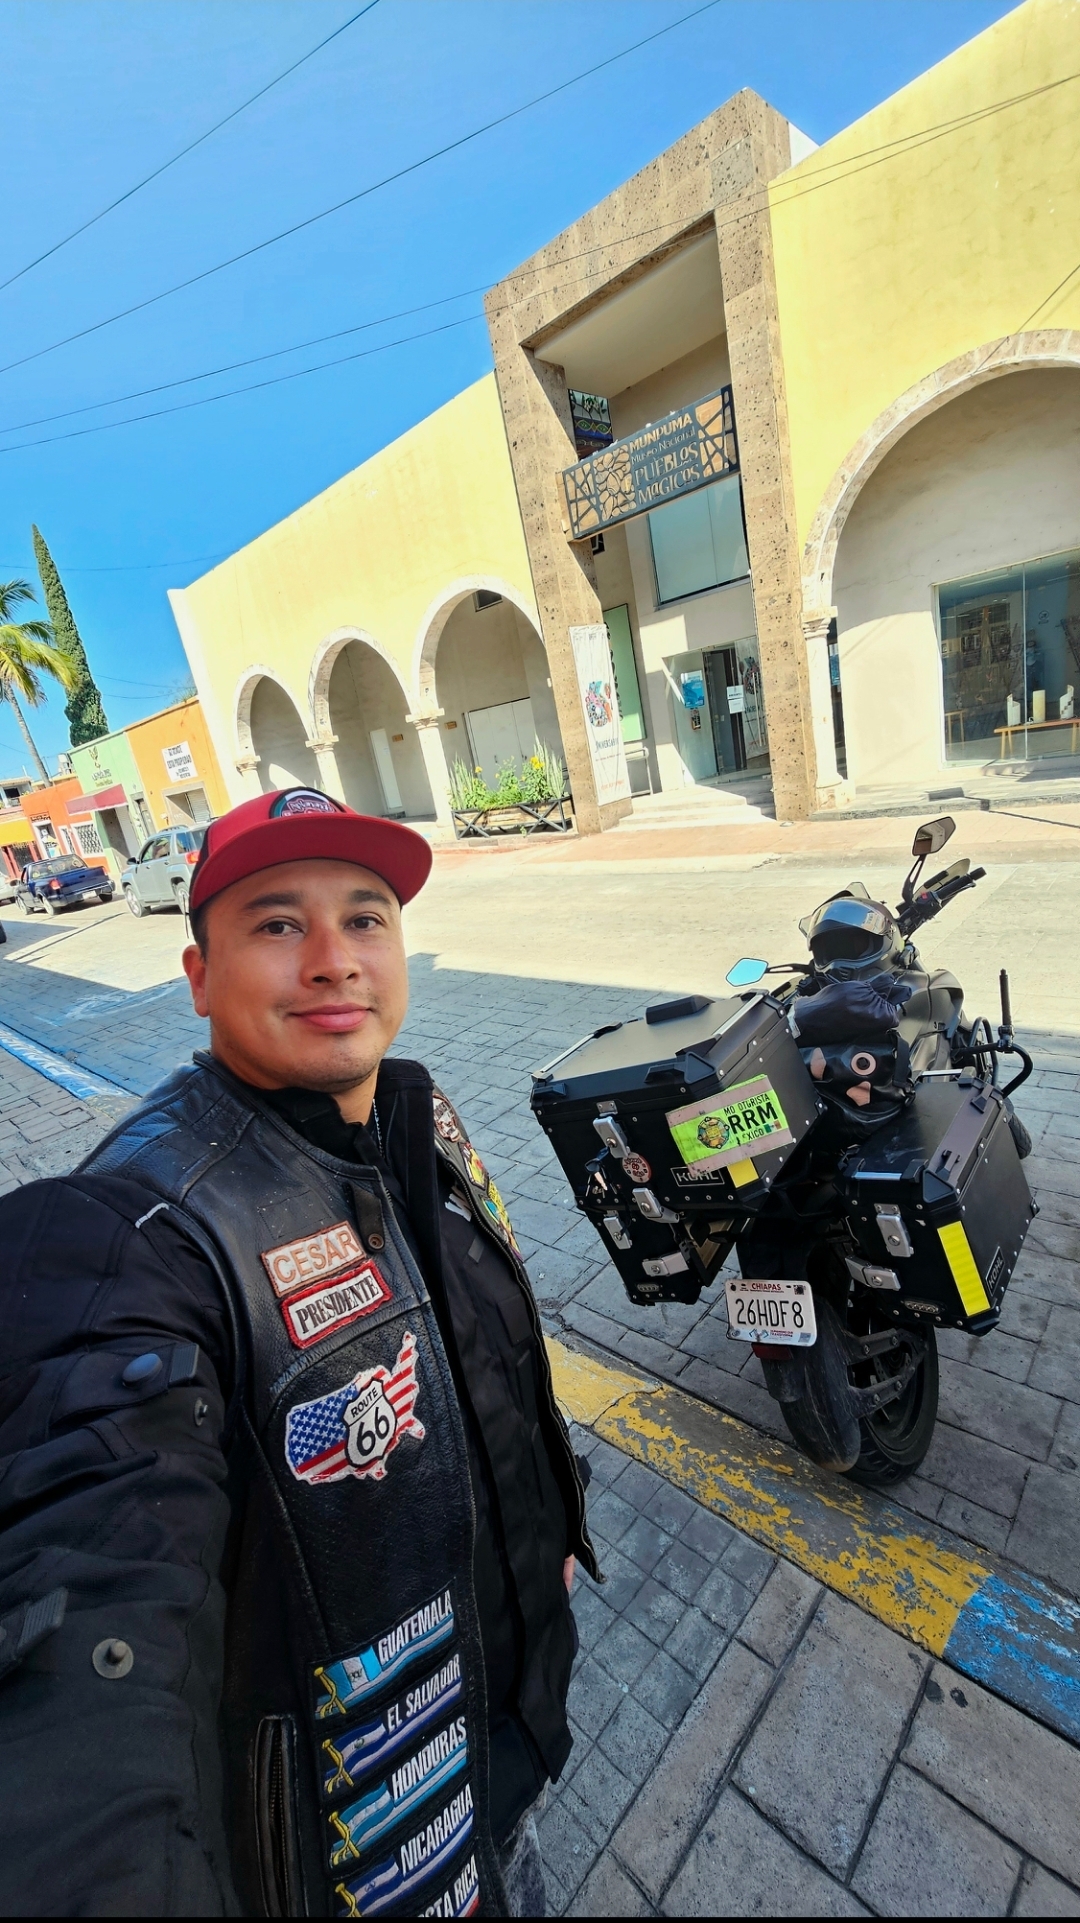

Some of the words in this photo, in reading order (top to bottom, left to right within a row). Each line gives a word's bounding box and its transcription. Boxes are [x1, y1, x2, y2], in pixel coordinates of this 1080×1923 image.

[629, 413, 693, 453] MUNPUMA
[631, 447, 658, 465] Museo
[659, 426, 696, 451] Nacional
[635, 442, 698, 486] PUEBLOS
[728, 1102, 778, 1134] RRM
[272, 1230, 360, 1284] CESAR
[296, 1275, 380, 1334] PRESIDENTE
[751, 1283, 782, 1291] CHIAPAS
[735, 1298, 804, 1328] 26HDF8
[351, 1387, 379, 1418] ROUTE
[356, 1406, 390, 1457] 66
[378, 1589, 453, 1666] GUATEMALA
[387, 1703, 402, 1735] EL
[406, 1653, 460, 1718] SALVADOR
[391, 1716, 467, 1802] HONDURAS
[401, 1783, 474, 1877] NICARAGUA
[454, 1854, 478, 1910] RICA
